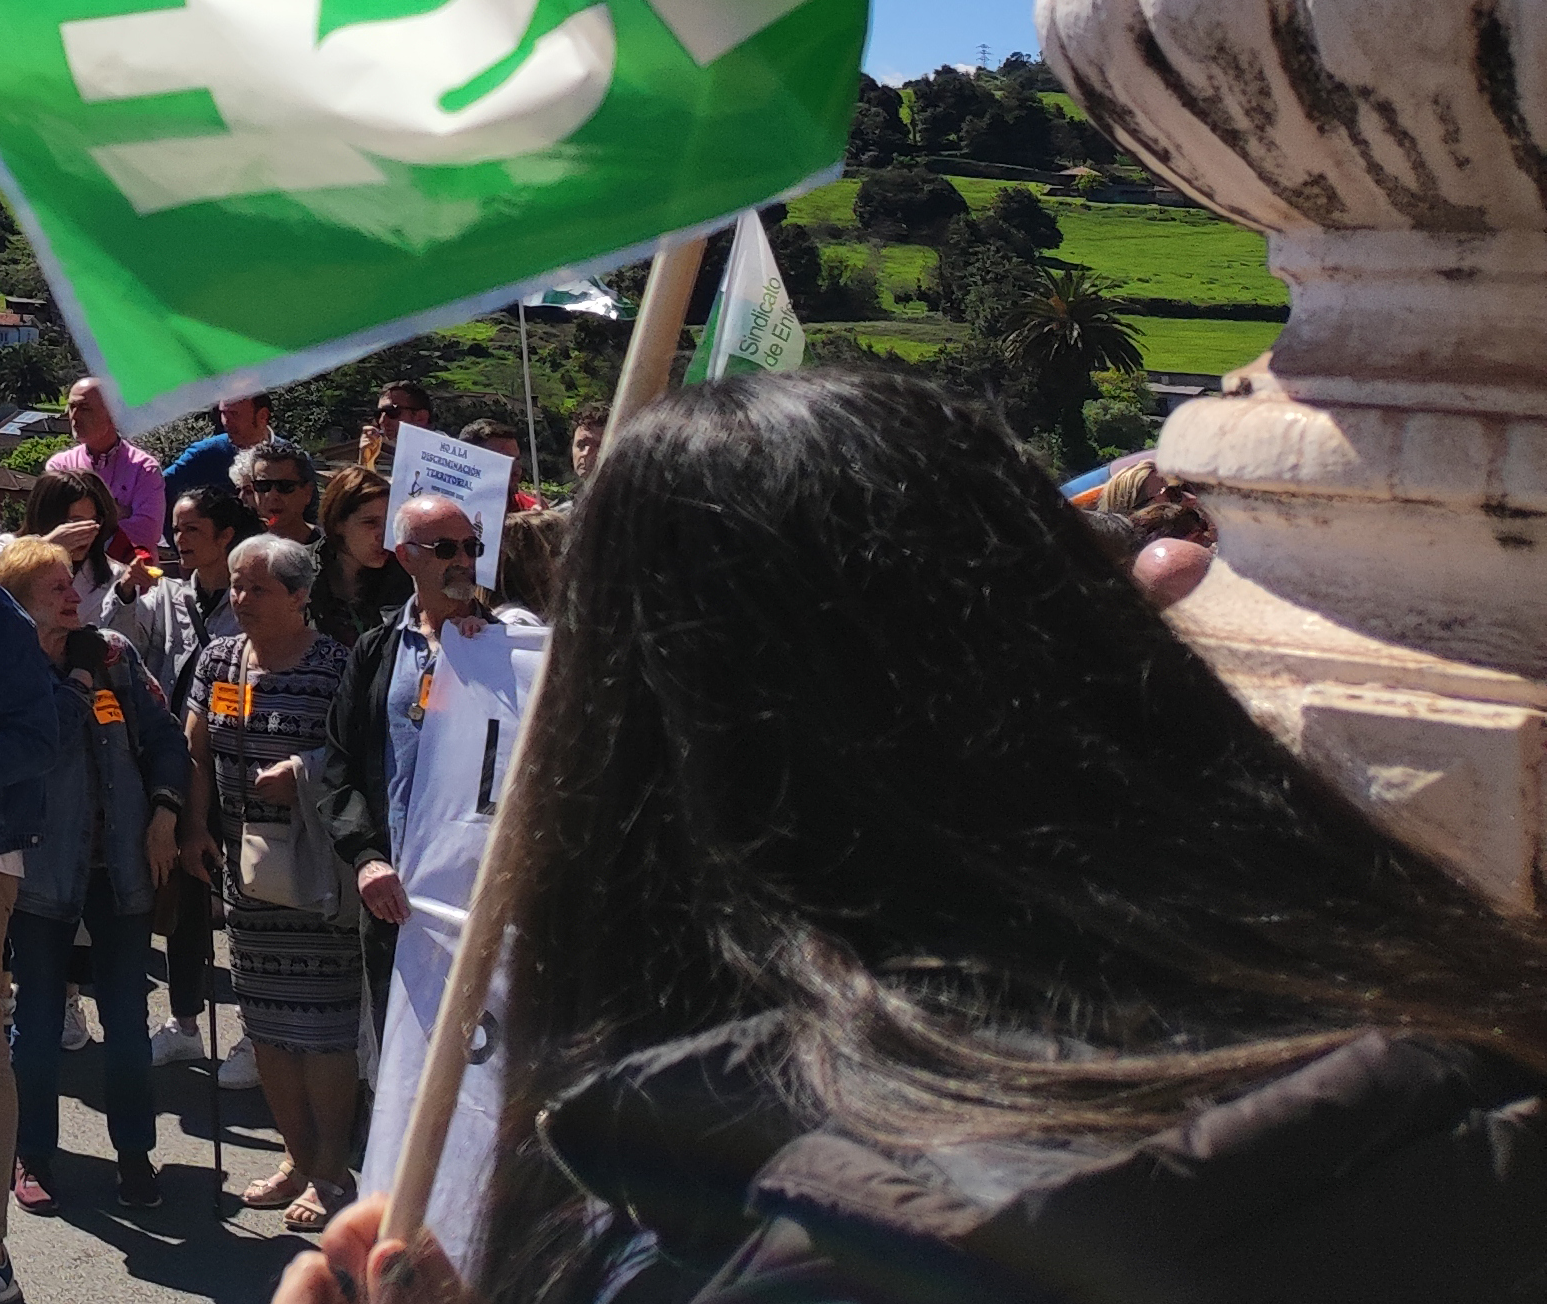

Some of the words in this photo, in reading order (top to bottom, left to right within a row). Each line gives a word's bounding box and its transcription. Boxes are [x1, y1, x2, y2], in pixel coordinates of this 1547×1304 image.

[739, 276, 782, 357] Sindicato
[763, 343, 784, 369] de
[420, 450, 482, 480] DISCRIMINACIÓN
[425, 467, 474, 491] TERRITORIAL
